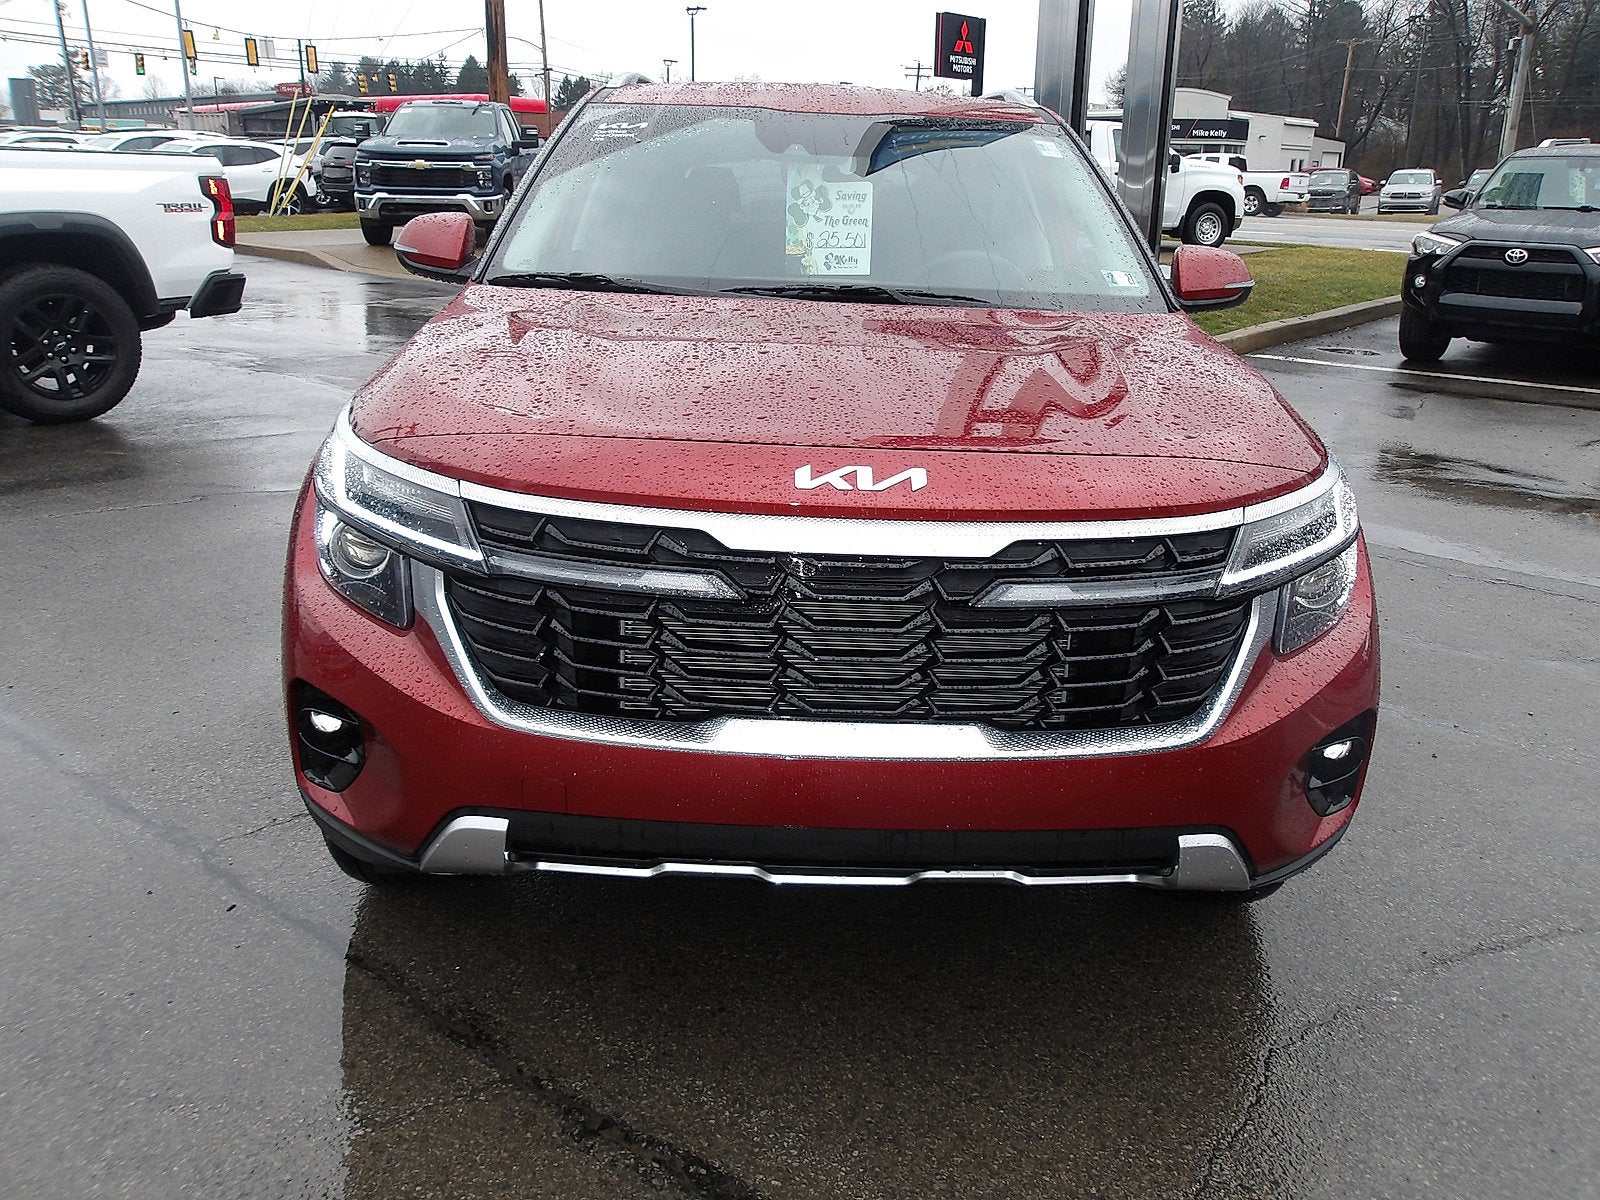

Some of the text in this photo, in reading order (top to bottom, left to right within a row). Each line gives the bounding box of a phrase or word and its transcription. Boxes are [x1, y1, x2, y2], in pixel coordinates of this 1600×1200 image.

[952, 64, 973, 74] MOTORS
[1192, 129, 1228, 138] Mike Kelly
[835, 190, 867, 202] Saving
[824, 215, 869, 228] The Green
[794, 464, 929, 493] KIA
